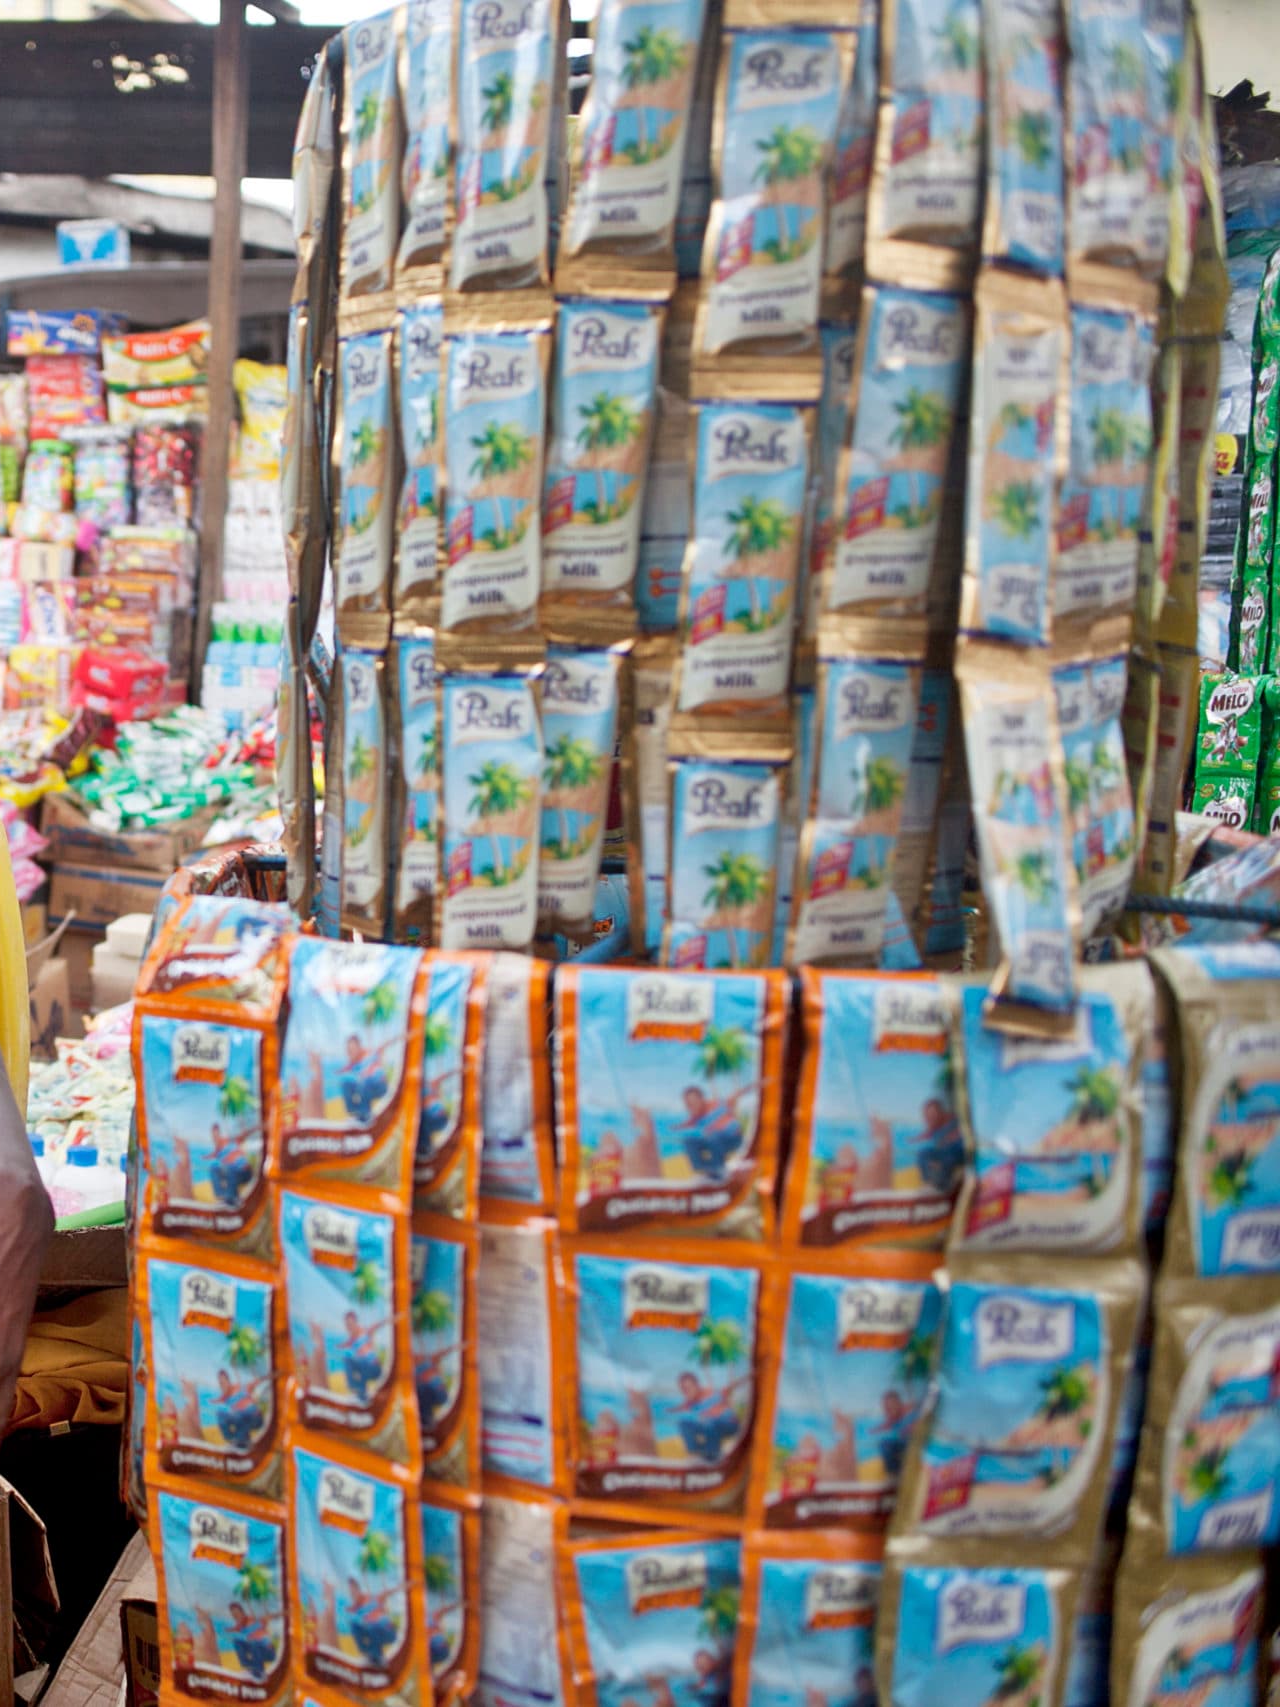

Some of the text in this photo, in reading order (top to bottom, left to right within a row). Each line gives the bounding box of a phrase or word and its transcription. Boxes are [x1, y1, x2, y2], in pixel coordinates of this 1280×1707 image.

[747, 49, 826, 90] Peak
[573, 318, 639, 359] Peak
[459, 352, 528, 390] Peak
[714, 420, 788, 464] Peak
[468, 589, 505, 604] Milk
[543, 663, 600, 702] Peak
[714, 673, 756, 688] Milk
[457, 692, 522, 730] Peak
[843, 679, 902, 721] Peak
[691, 778, 761, 819] Peak
[466, 925, 502, 939] Milk
[181, 1032, 220, 1062] Peak
[187, 1277, 228, 1309] Peak
[630, 1273, 696, 1303] Peak
[846, 1291, 909, 1324] Peak
[985, 1302, 1057, 1345] Peak
[325, 1478, 365, 1511] Peak
[196, 1511, 240, 1547] Peak
[948, 1586, 1007, 1627] Peak
